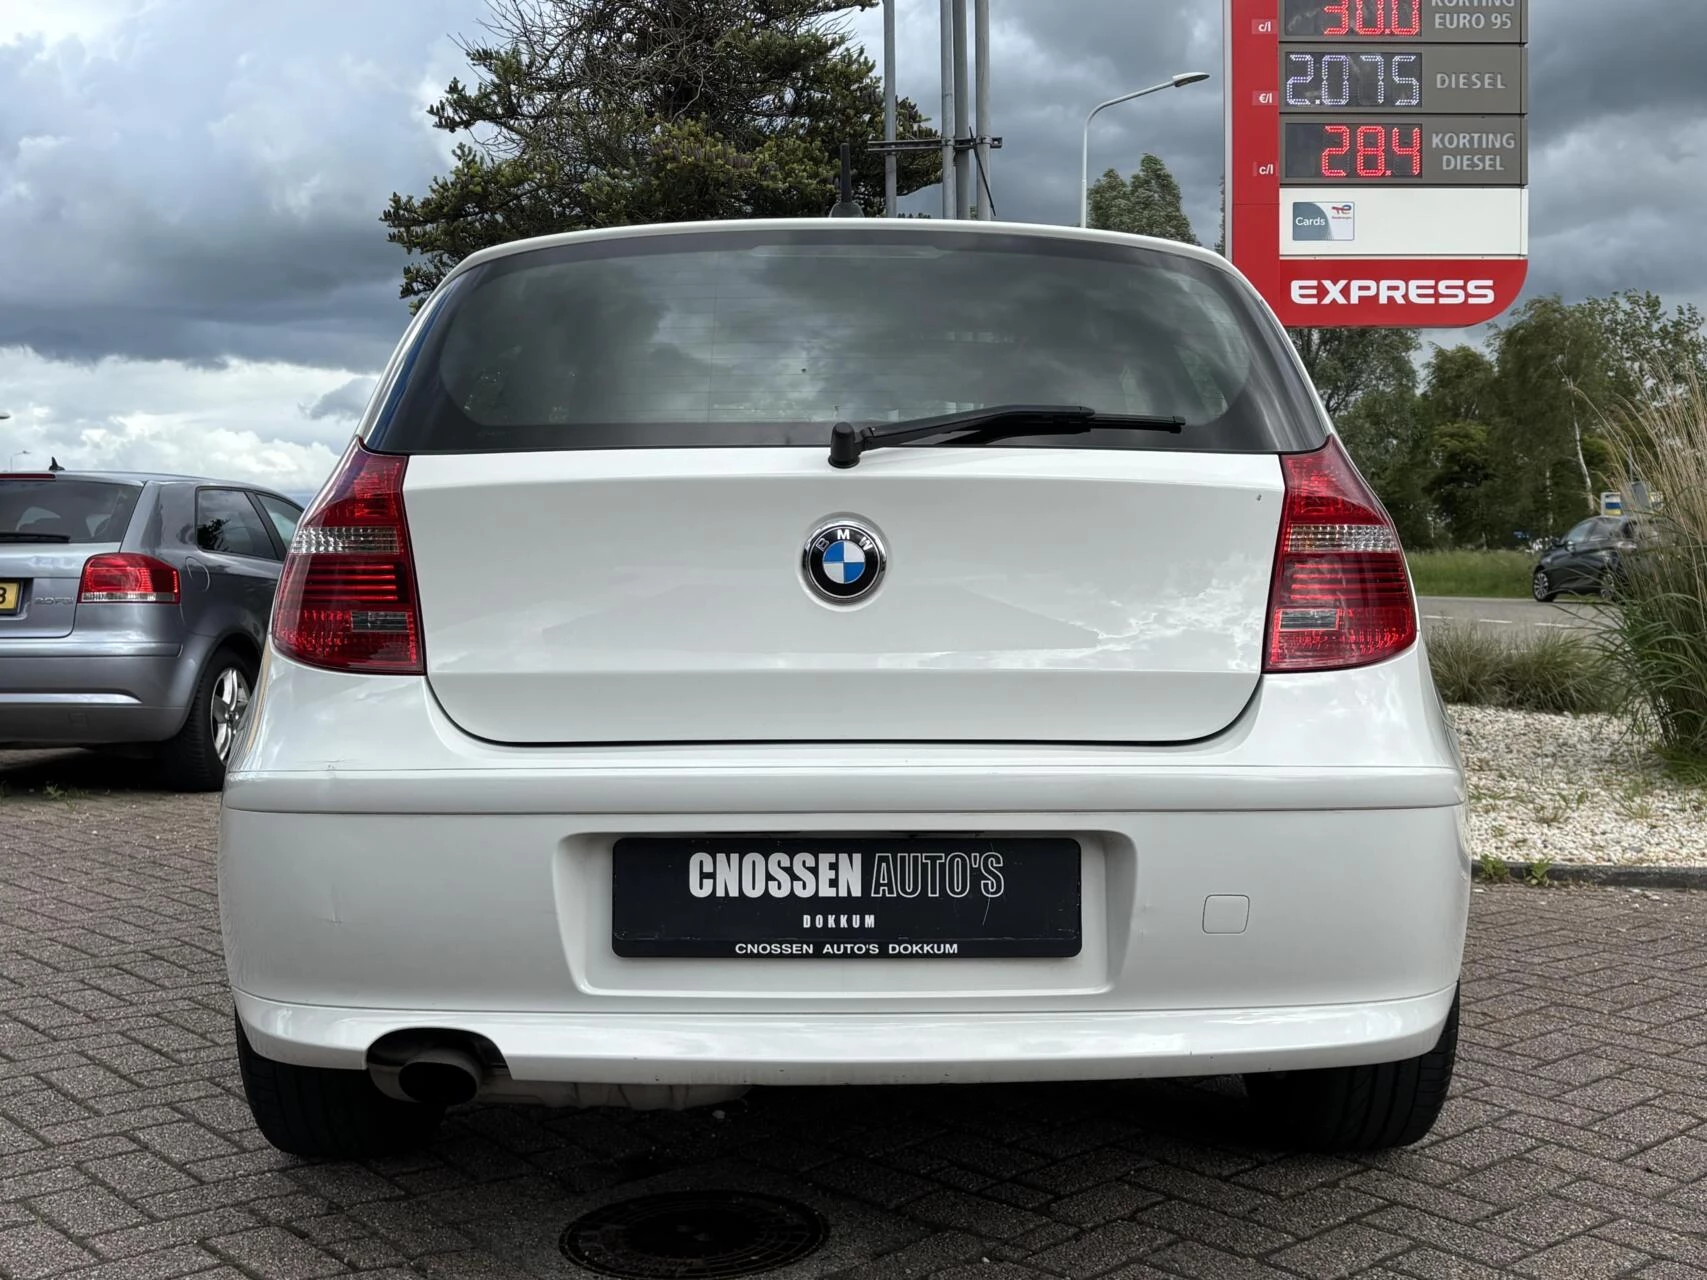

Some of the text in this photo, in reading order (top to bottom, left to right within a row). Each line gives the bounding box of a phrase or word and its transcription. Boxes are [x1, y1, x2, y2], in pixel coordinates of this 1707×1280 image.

[1434, 13, 1512, 29] EURO 95
[1286, 54, 1420, 106] 2.075
[1436, 73, 1506, 89] DIESEL
[1431, 133, 1515, 149] KORTING
[1322, 126, 1420, 176] 28.4
[1442, 155, 1505, 171] DIESEL
[1295, 216, 1326, 226] Cards
[1290, 279, 1495, 305] EXPRESS
[816, 529, 873, 552] BMW
[689, 851, 1004, 898] CNOSSEN AUTO'S
[803, 914, 875, 929] DOKKUM
[735, 943, 958, 955] CNOSSEN AUTO'S DOKKUM
